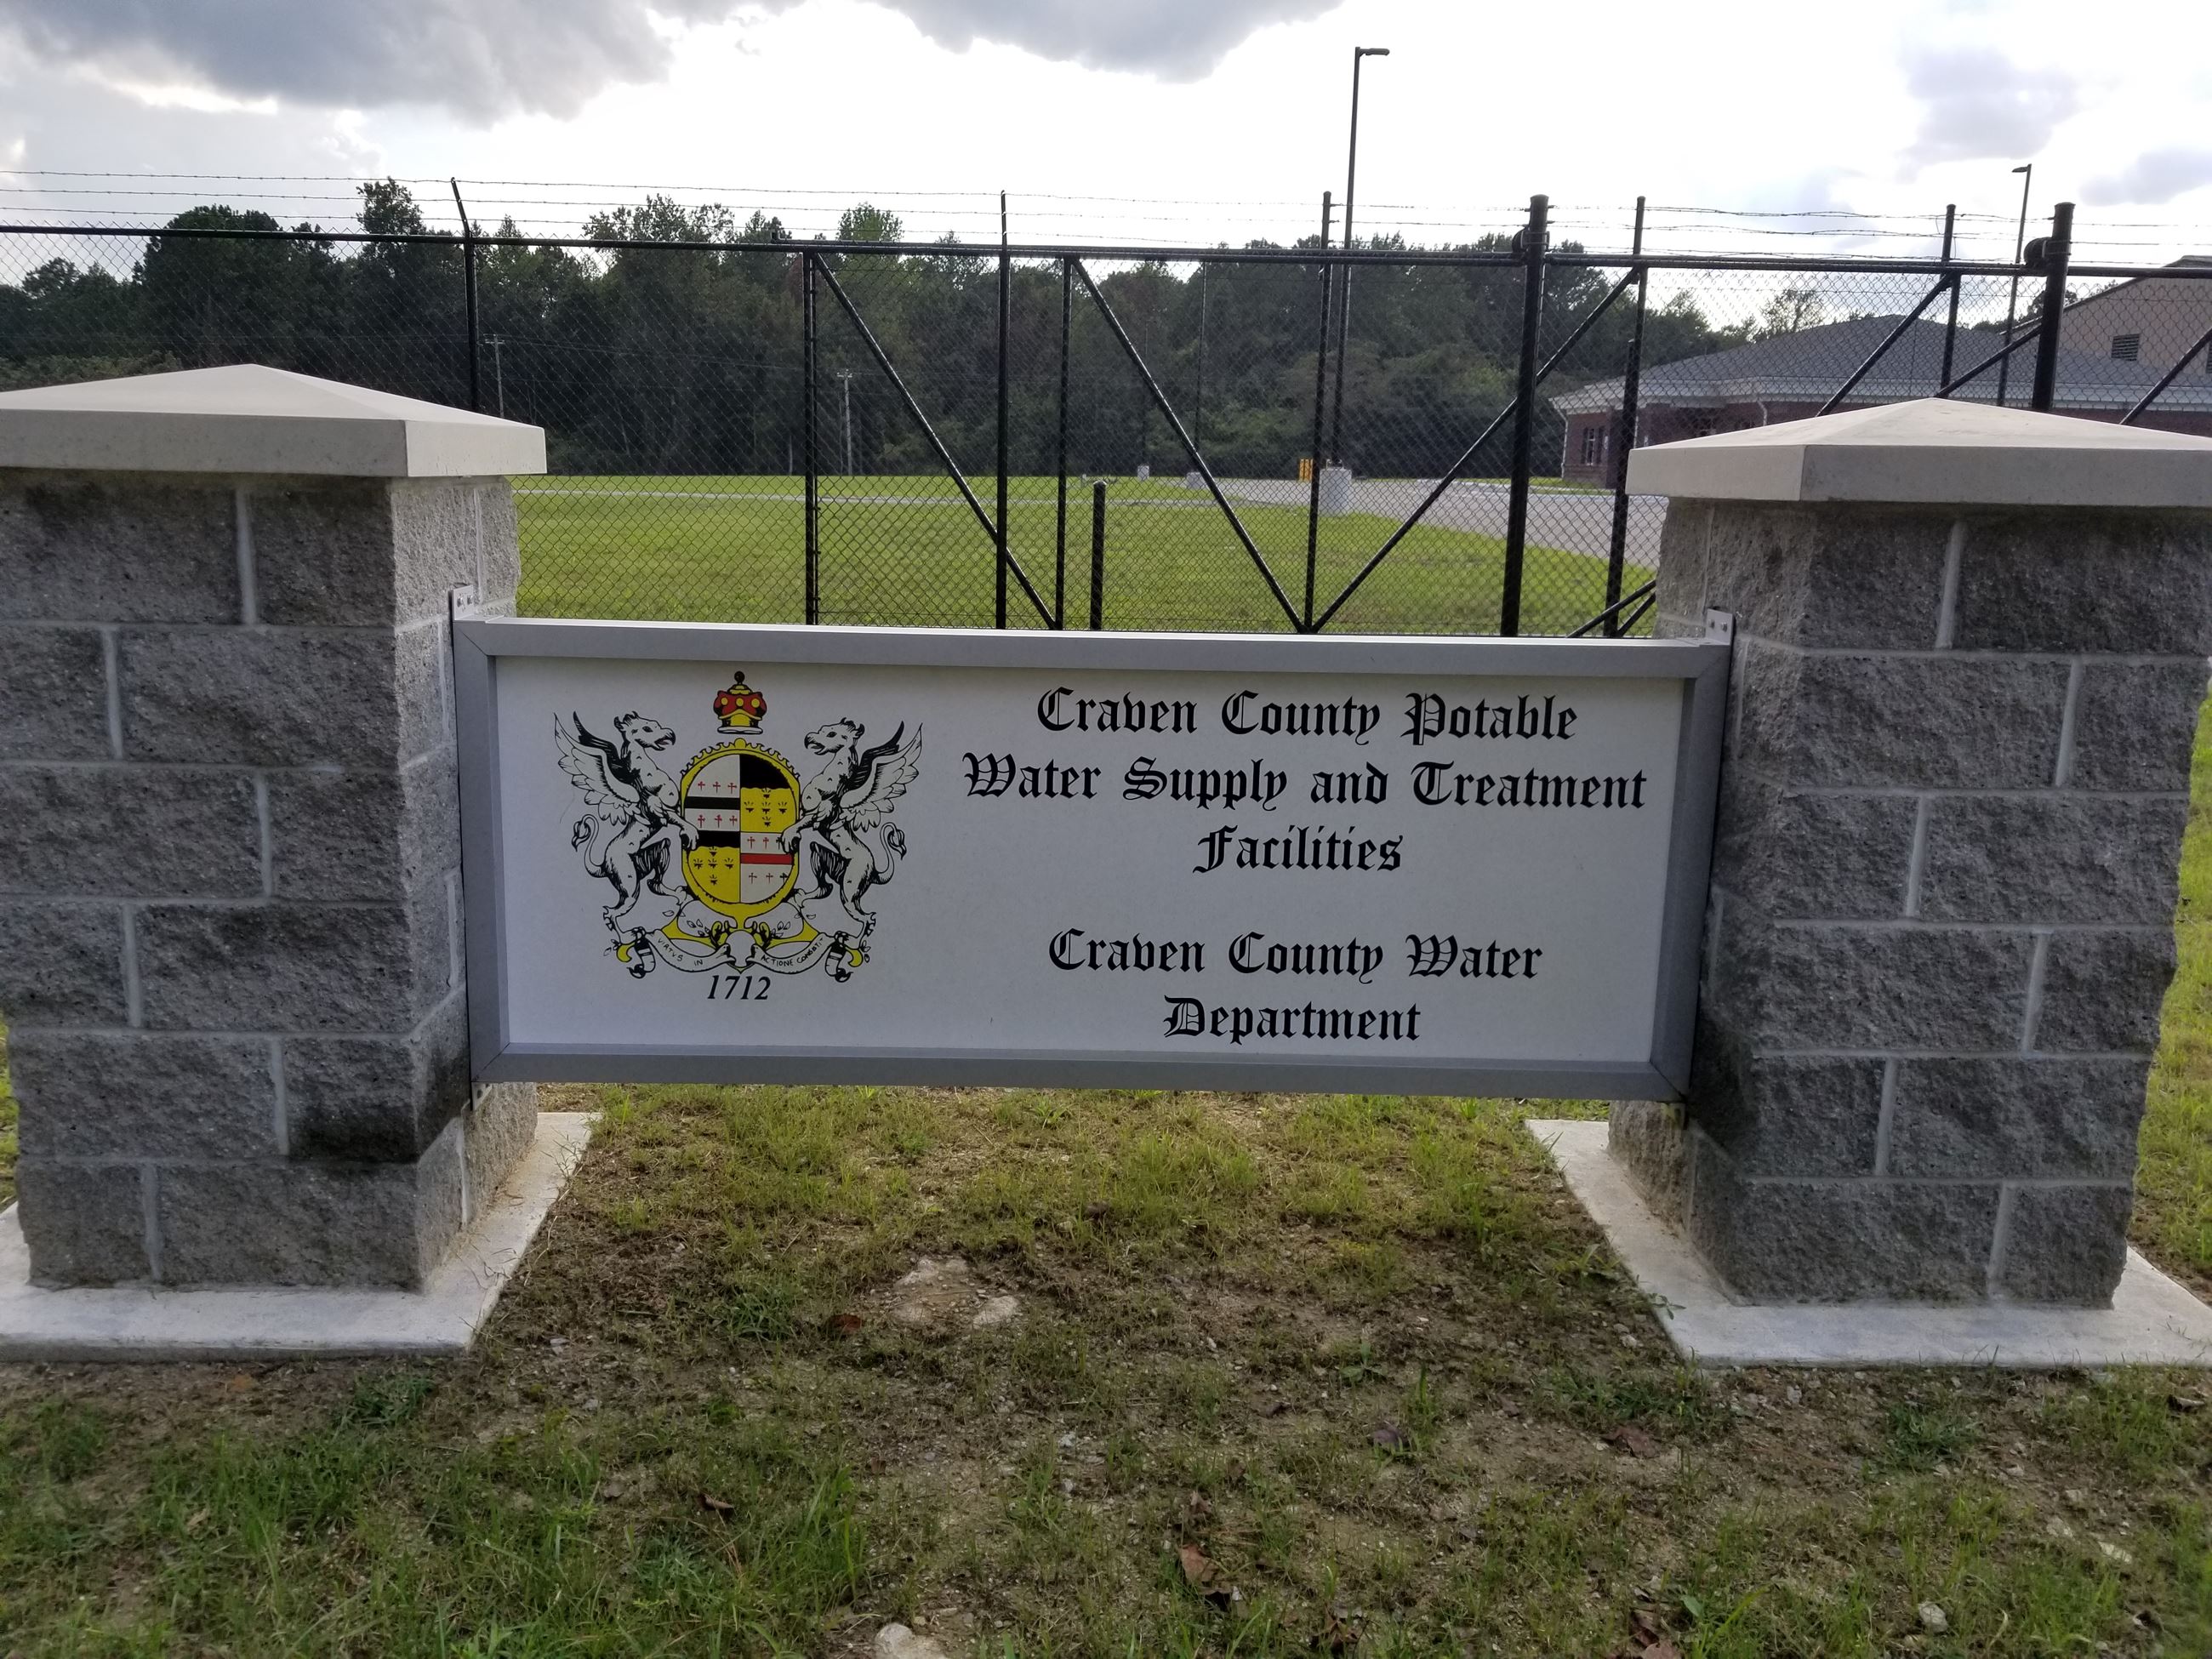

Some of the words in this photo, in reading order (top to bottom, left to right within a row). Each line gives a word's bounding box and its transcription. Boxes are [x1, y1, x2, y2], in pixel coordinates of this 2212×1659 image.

[1037, 686, 1198, 734] Craven
[1221, 689, 1381, 746] County
[1400, 692, 1578, 746] Potable
[961, 752, 1102, 800] Water
[1122, 755, 1287, 812] Supply
[1310, 761, 1389, 805] and
[1411, 761, 1647, 809] Treatment
[1192, 824, 1404, 874] Facilities
[1048, 927, 1206, 973] Craven
[1228, 931, 1383, 984] County
[1405, 933, 1543, 979] Water
[707, 974, 772, 1001] 1712
[1163, 995, 1422, 1046] Department
